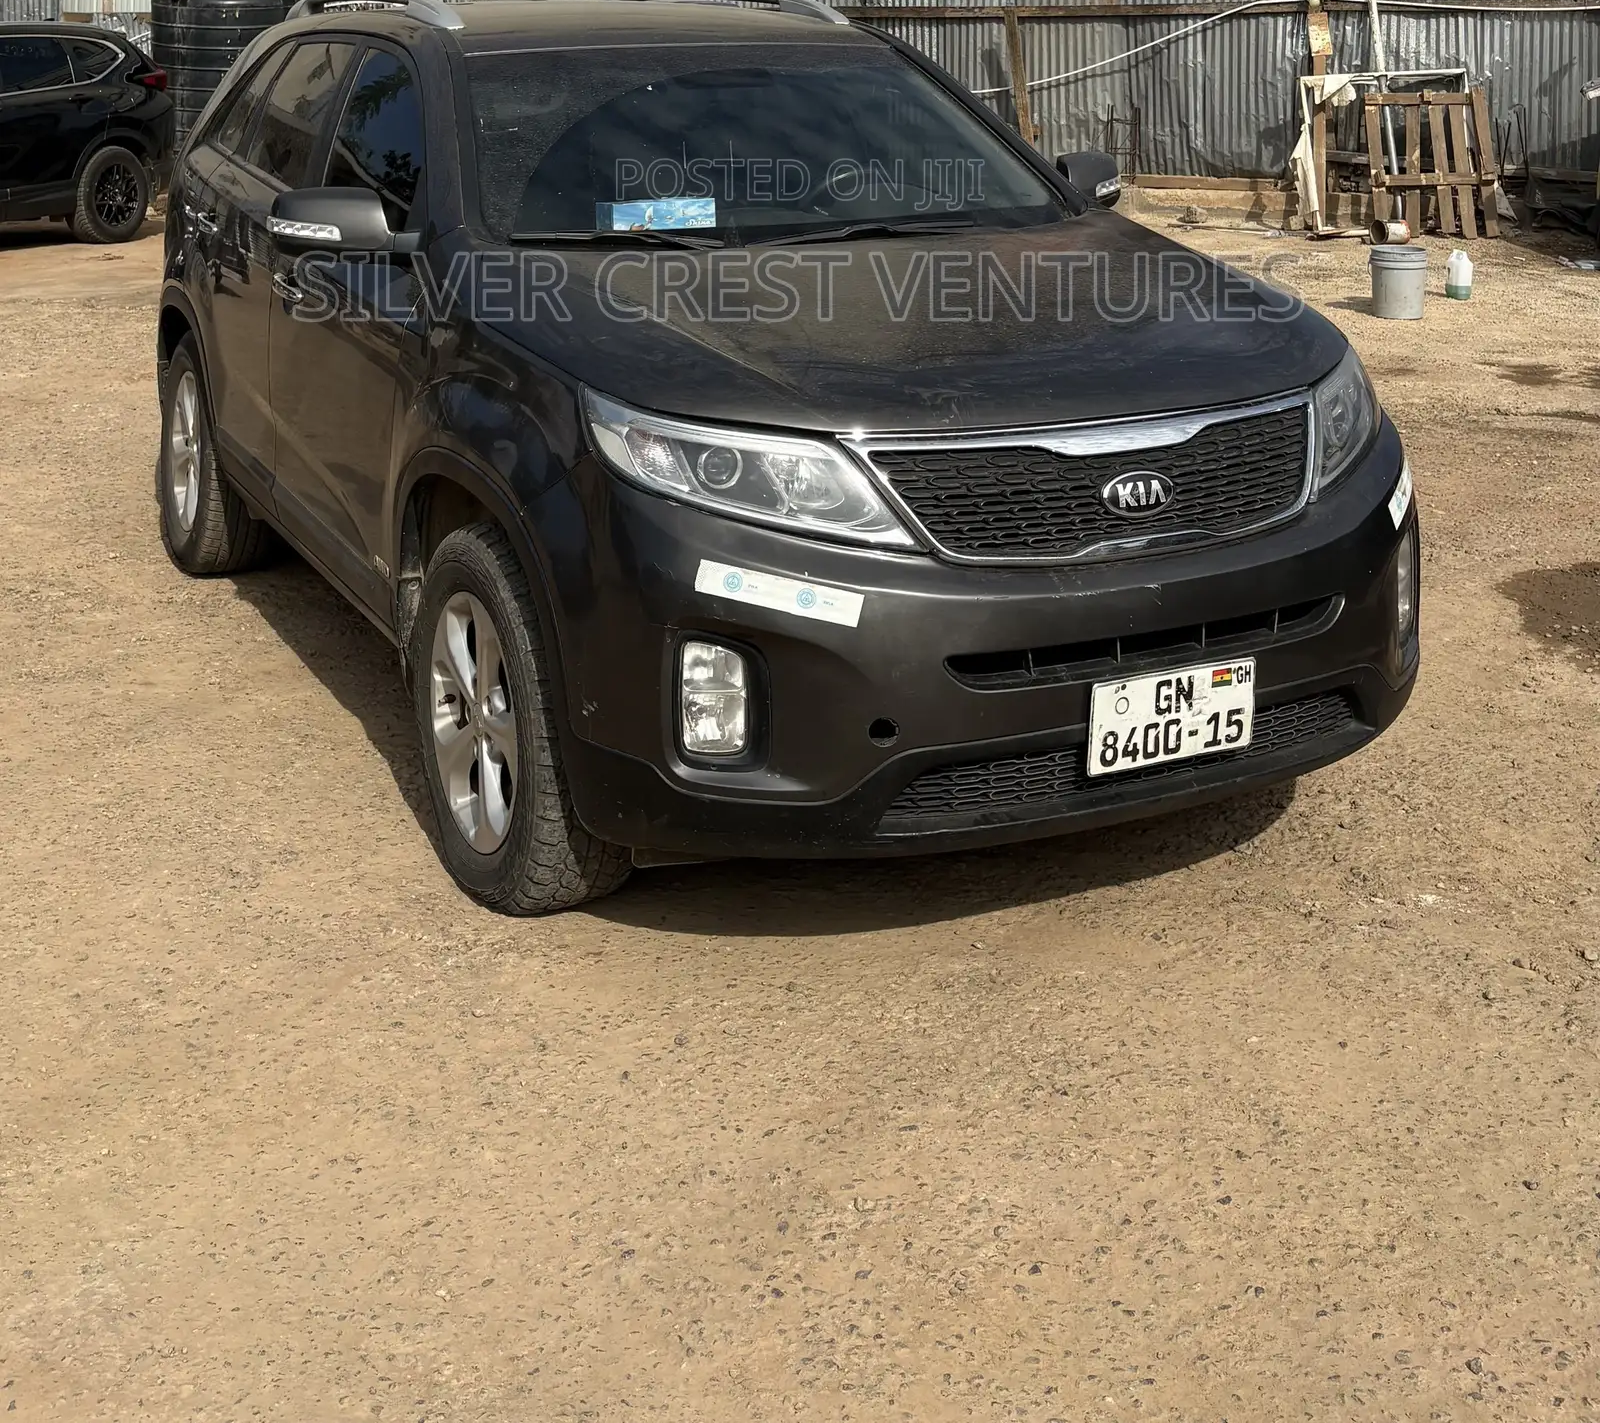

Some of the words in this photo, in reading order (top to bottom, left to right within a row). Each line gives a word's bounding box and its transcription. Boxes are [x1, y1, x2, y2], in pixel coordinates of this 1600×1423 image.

[1115, 479, 1167, 508] KIA
[1155, 675, 1194, 715] GN
[1236, 664, 1251, 684] GH
[1100, 707, 1245, 768] 8400-15
